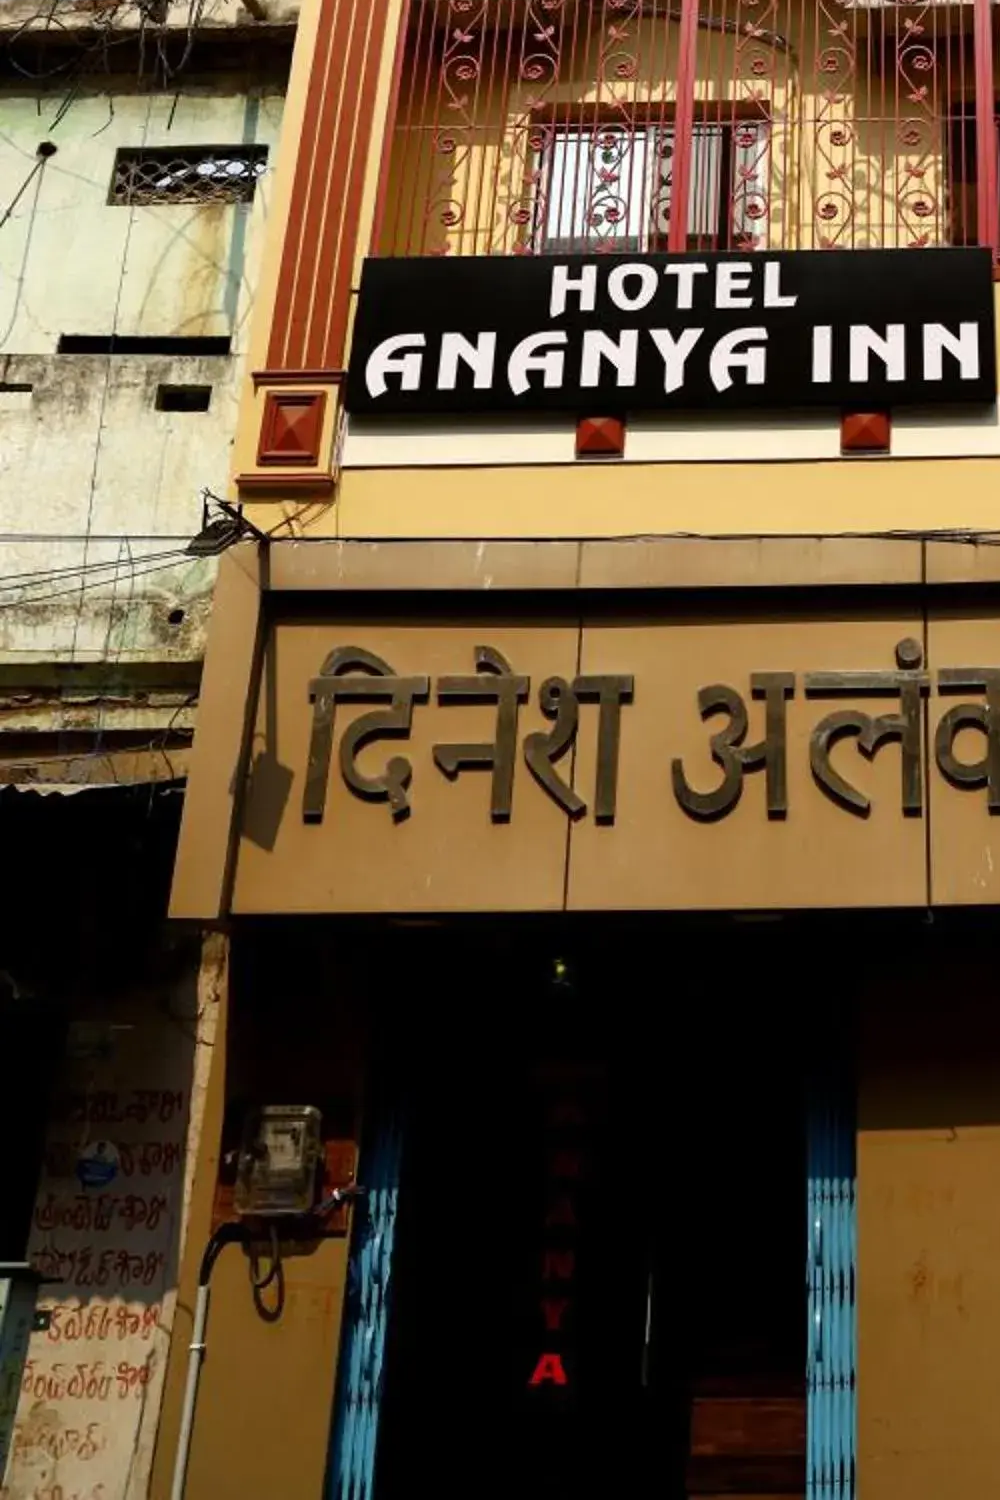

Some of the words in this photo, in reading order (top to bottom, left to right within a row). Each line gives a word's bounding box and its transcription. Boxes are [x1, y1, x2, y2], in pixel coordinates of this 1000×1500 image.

[549, 261, 798, 317] HOTEL
[365, 327, 768, 398] ANANYA
[811, 322, 980, 383] INN
[301, 645, 636, 826] दिनेश
